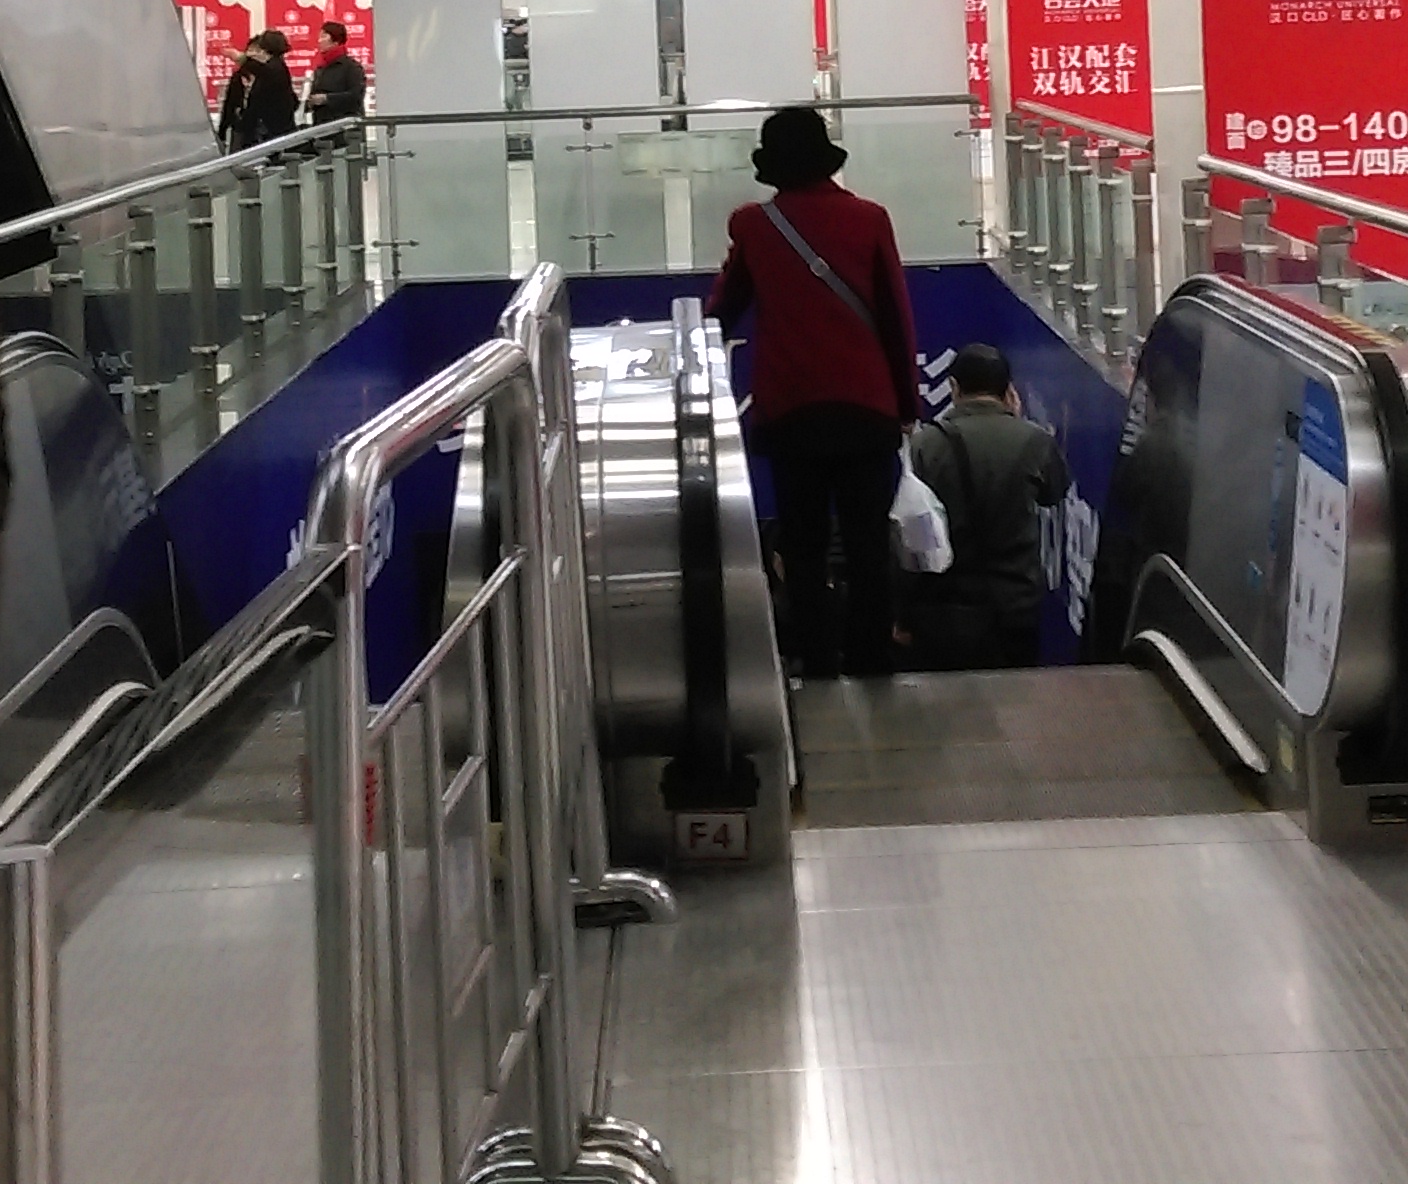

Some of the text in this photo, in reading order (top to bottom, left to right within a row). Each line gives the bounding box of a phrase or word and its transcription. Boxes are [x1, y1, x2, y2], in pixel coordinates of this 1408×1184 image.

[1029, 42, 1139, 71] 江汉配套
[1032, 70, 1139, 96] 双轨交汇
[689, 821, 730, 850] F4
